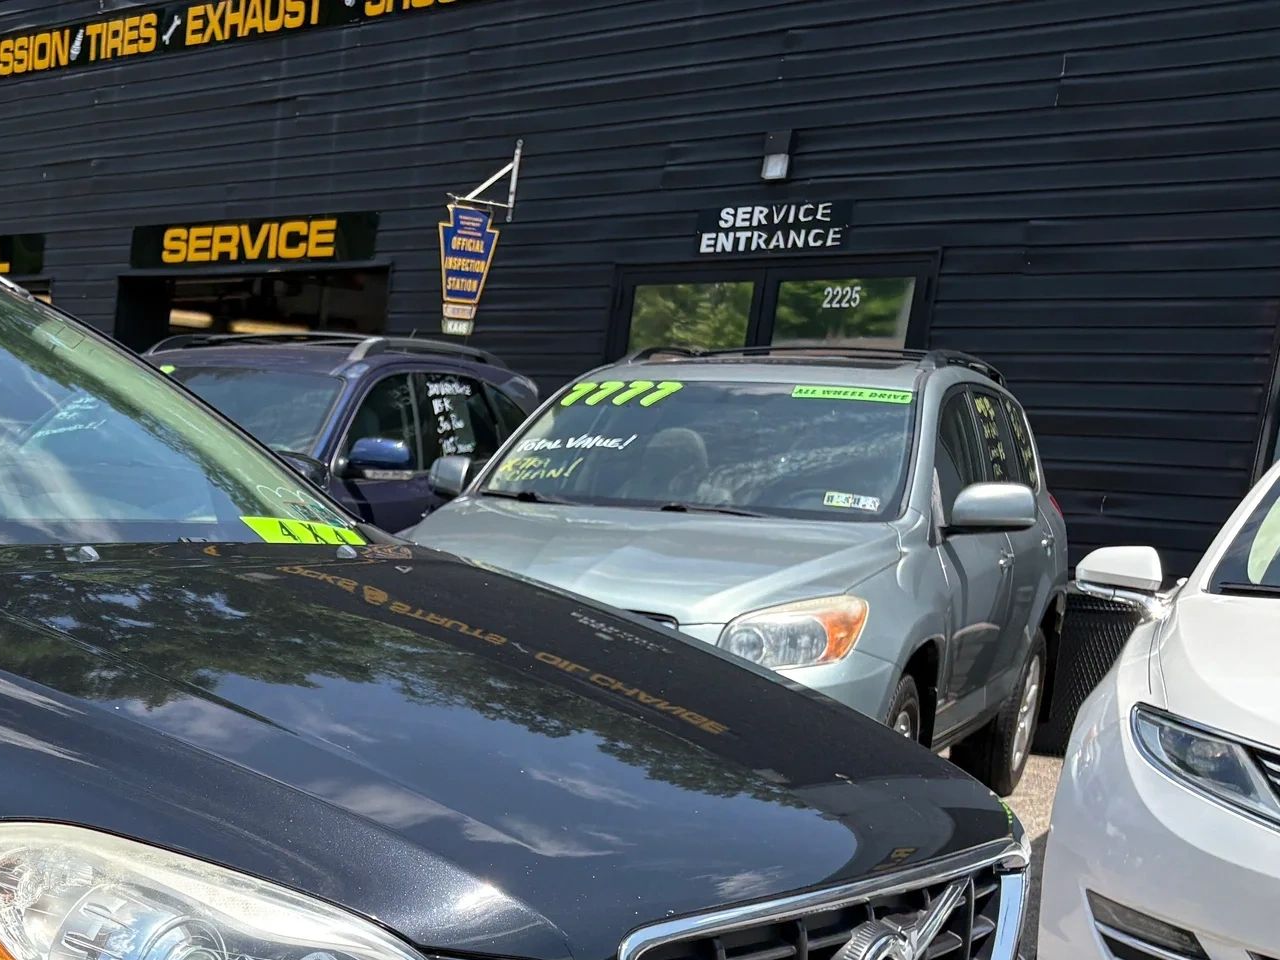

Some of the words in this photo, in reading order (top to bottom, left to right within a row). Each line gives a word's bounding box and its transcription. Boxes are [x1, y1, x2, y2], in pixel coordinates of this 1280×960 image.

[185, 0, 321, 46] EXHAUST
[86, 13, 157, 61] TIRES
[719, 202, 832, 228] SERVICE
[162, 219, 337, 264] SERVICE
[451, 236, 485, 254] OFFICIAL
[700, 227, 842, 254] ENTRANCE
[444, 256, 487, 273] INSPECTION
[446, 277, 478, 292] STATION
[822, 286, 861, 308] 2225
[560, 380, 684, 407] 7777
[822, 389, 864, 397] WHEEL
[869, 391, 910, 401] DRIVE
